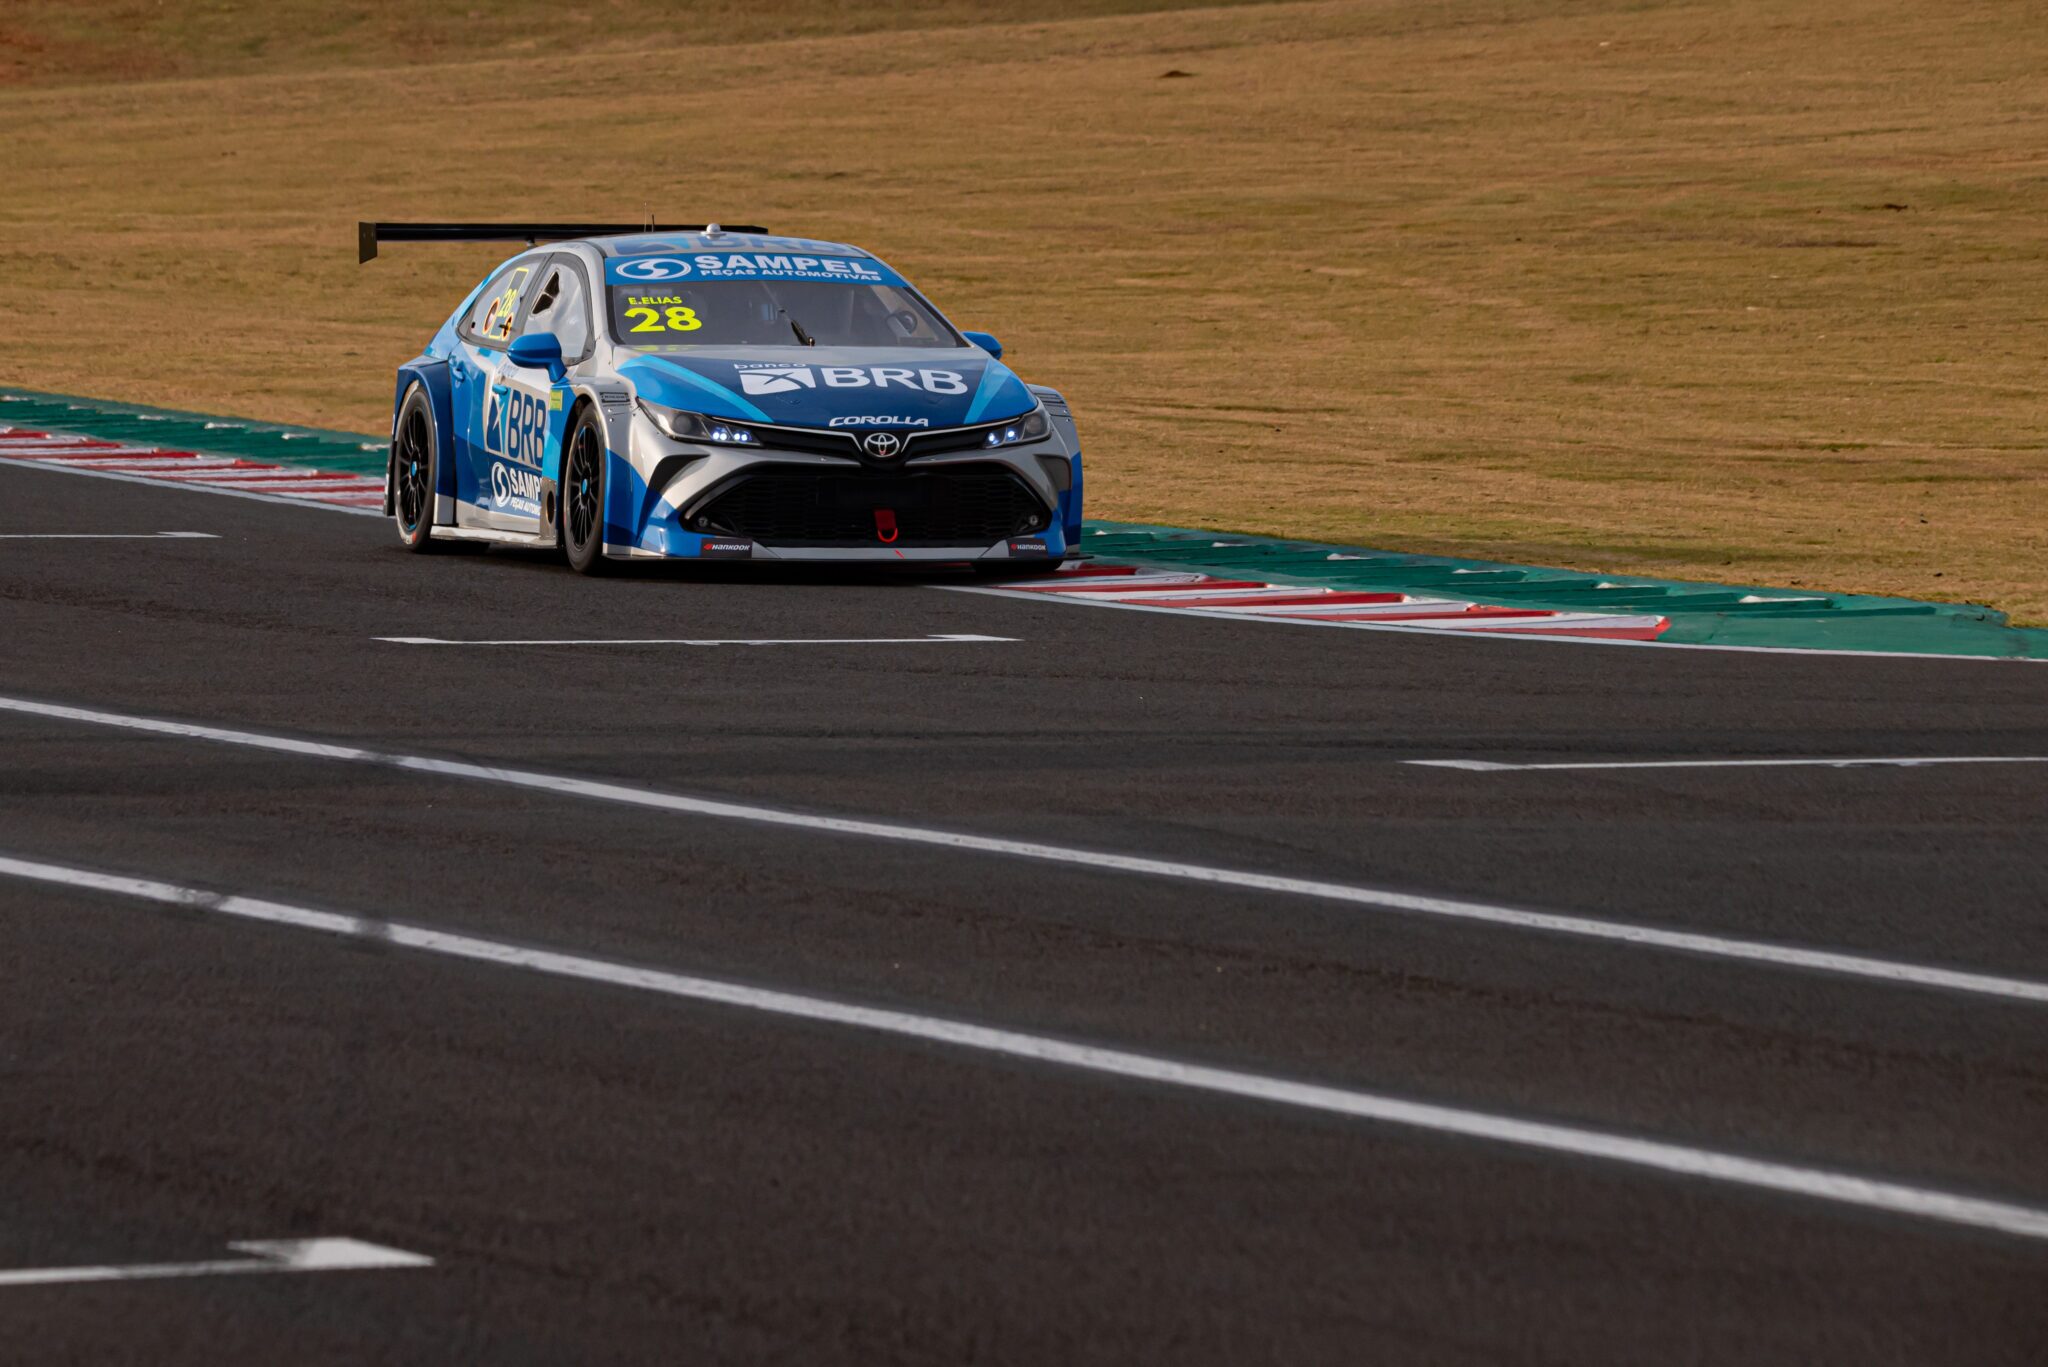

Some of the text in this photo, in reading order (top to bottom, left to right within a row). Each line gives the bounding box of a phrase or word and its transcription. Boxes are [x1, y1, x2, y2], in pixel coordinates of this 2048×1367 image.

[694, 254, 878, 275] SAMPEL
[762, 269, 882, 281] AUTOMOTIVAS
[628, 296, 682, 305] E.ELIAS
[624, 307, 702, 332] 28
[820, 367, 968, 395] BRB
[507, 389, 546, 468] BRB
[829, 415, 929, 427] COROLLA
[510, 467, 542, 501] SAMP
